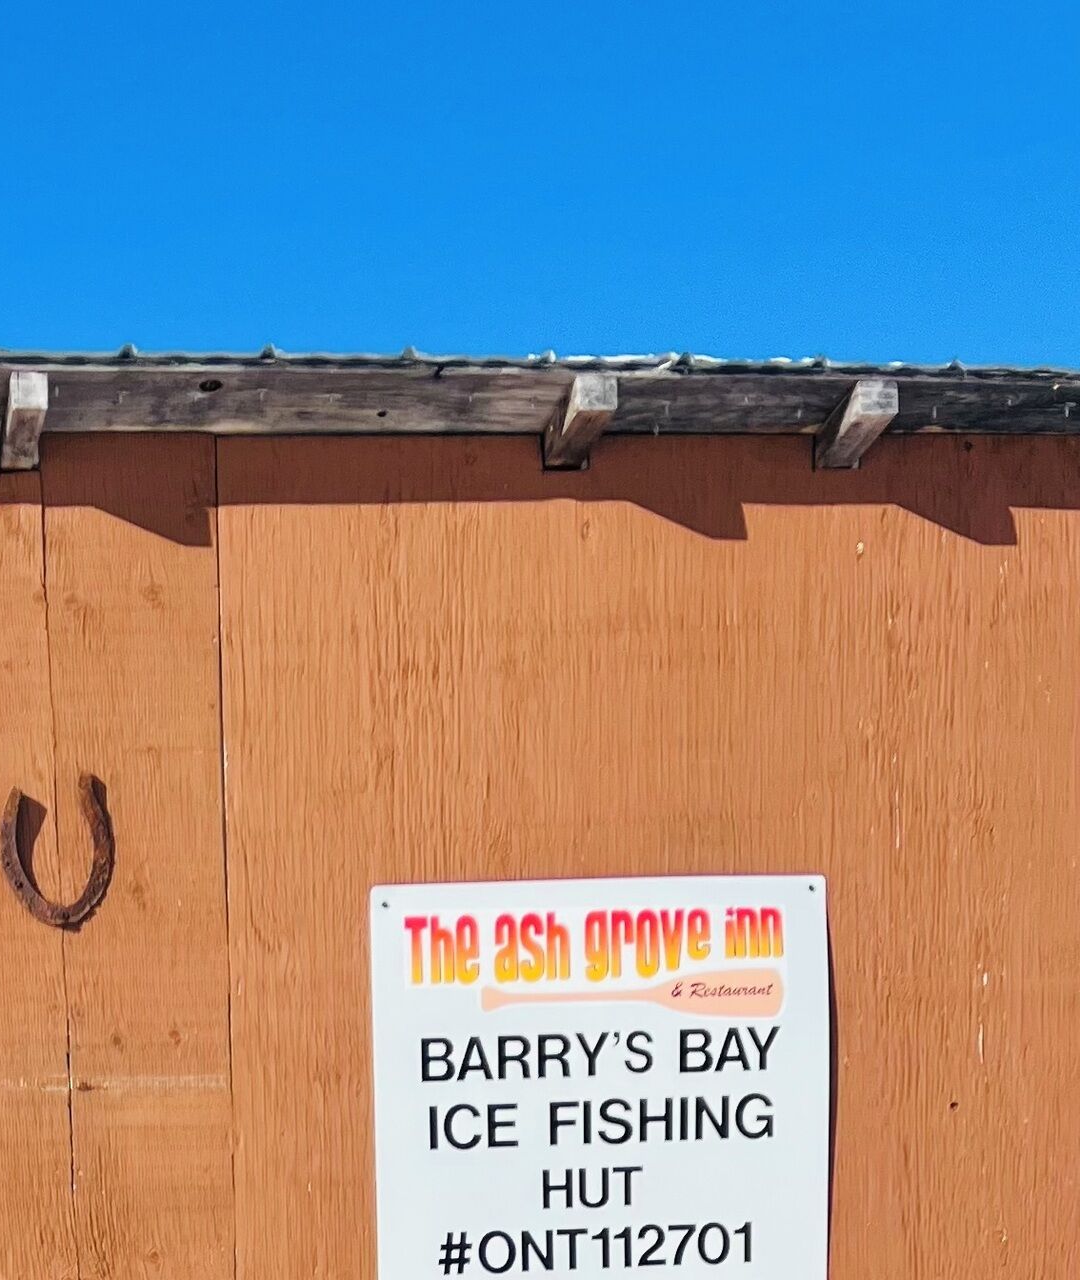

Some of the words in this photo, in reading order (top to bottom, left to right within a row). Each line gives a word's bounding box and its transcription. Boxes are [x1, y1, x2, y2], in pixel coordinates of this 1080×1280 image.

[404, 913, 480, 985] The
[494, 911, 571, 984] ash
[584, 907, 711, 983] grove
[724, 906, 784, 960] inn
[671, 981, 683, 998] &
[689, 981, 774, 999] Restaurant
[420, 1030, 653, 1083] BARRY'S
[679, 1026, 780, 1073] BAY
[429, 1103, 519, 1150] ICE
[549, 1093, 774, 1146] FISHING
[542, 1166, 643, 1209] HUT
[438, 1221, 752, 1276] #ONT112701
